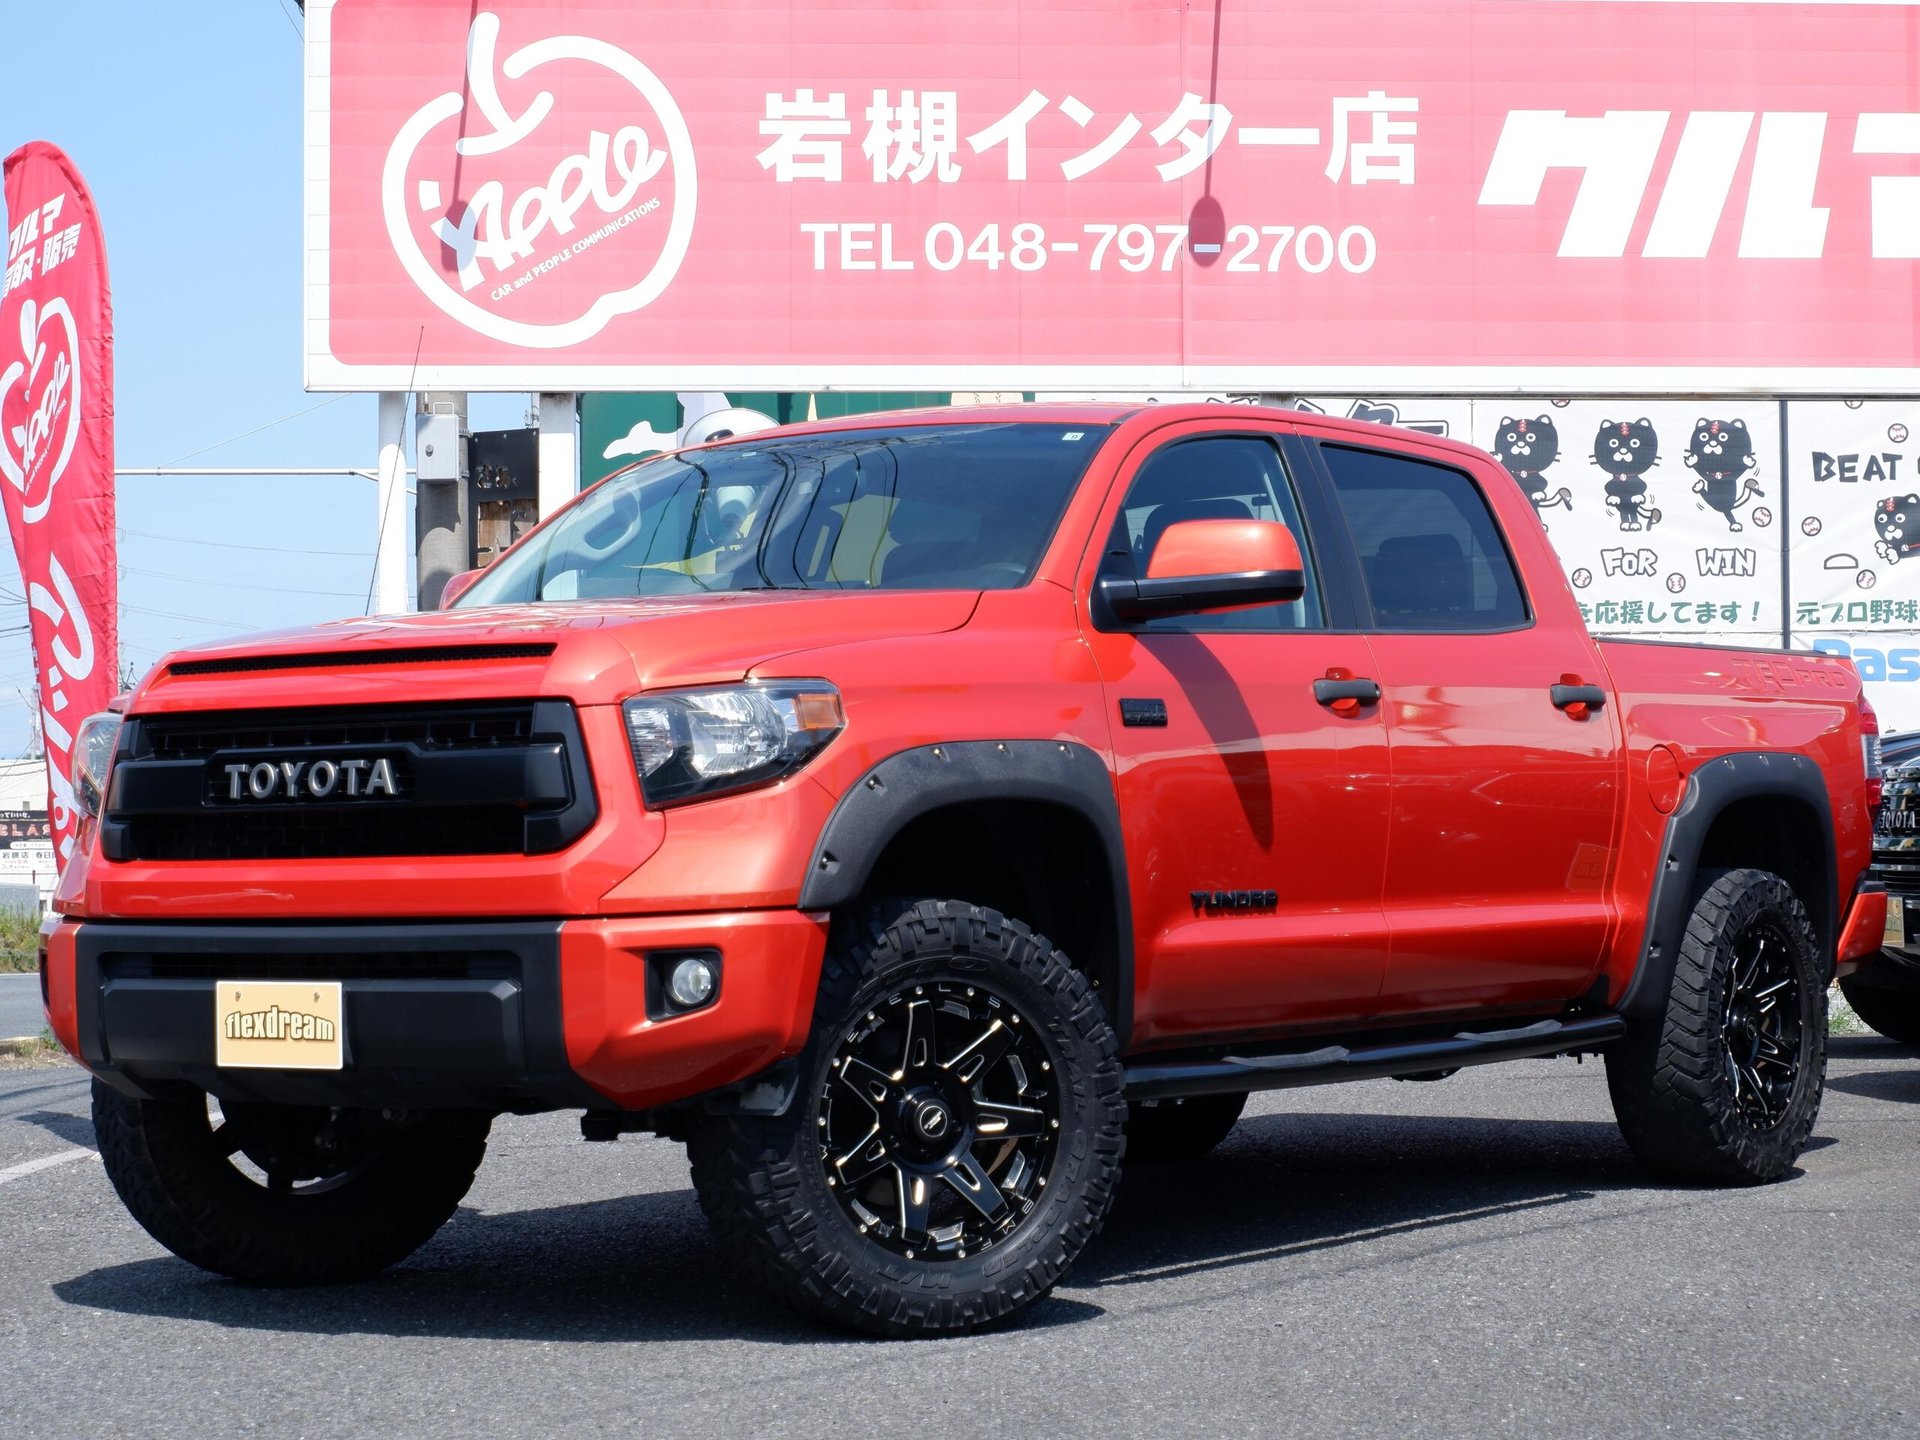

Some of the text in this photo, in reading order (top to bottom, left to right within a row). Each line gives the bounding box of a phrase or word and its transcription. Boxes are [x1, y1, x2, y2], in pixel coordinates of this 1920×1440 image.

[756, 89, 1419, 185] 岩槻インター店
[422, 125, 668, 292] Apple
[491, 197, 661, 301] CAR and PEOPLE COMMUNICATIONS
[800, 222, 1377, 273] TEL 048-797-2700
[1811, 451, 1903, 483] BEAT
[1600, 547, 1757, 578] FOR WIN
[224, 758, 399, 800] TOYOTA
[225, 1005, 335, 1042] flexdream
